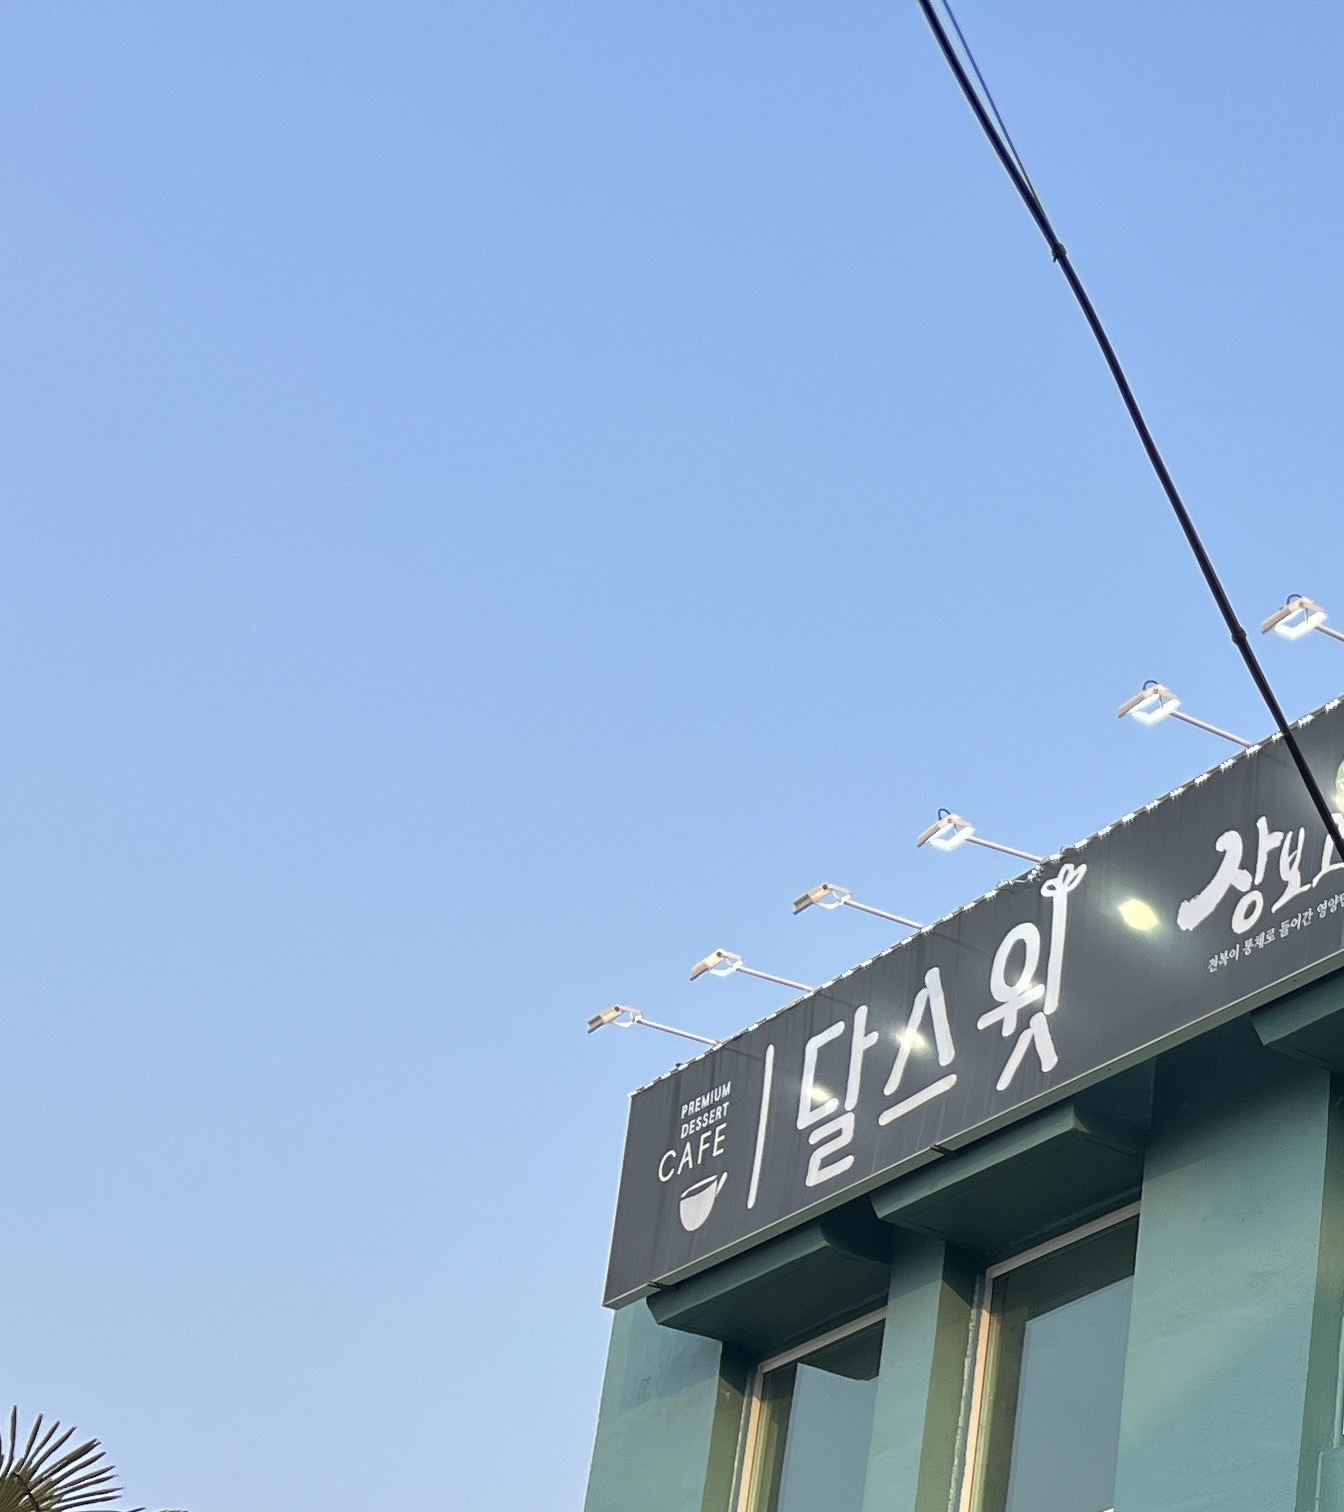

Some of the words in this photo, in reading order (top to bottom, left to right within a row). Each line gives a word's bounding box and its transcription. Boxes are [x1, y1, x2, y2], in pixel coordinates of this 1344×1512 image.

[1208, 944, 1240, 973] 전복이
[1279, 907, 1313, 938] 들어간
[796, 863, 1087, 1187] 달스윗
[680, 1080, 732, 1119] PREMIUM
[680, 1101, 730, 1139] DESSERT
[658, 1123, 727, 1182] CAFE
